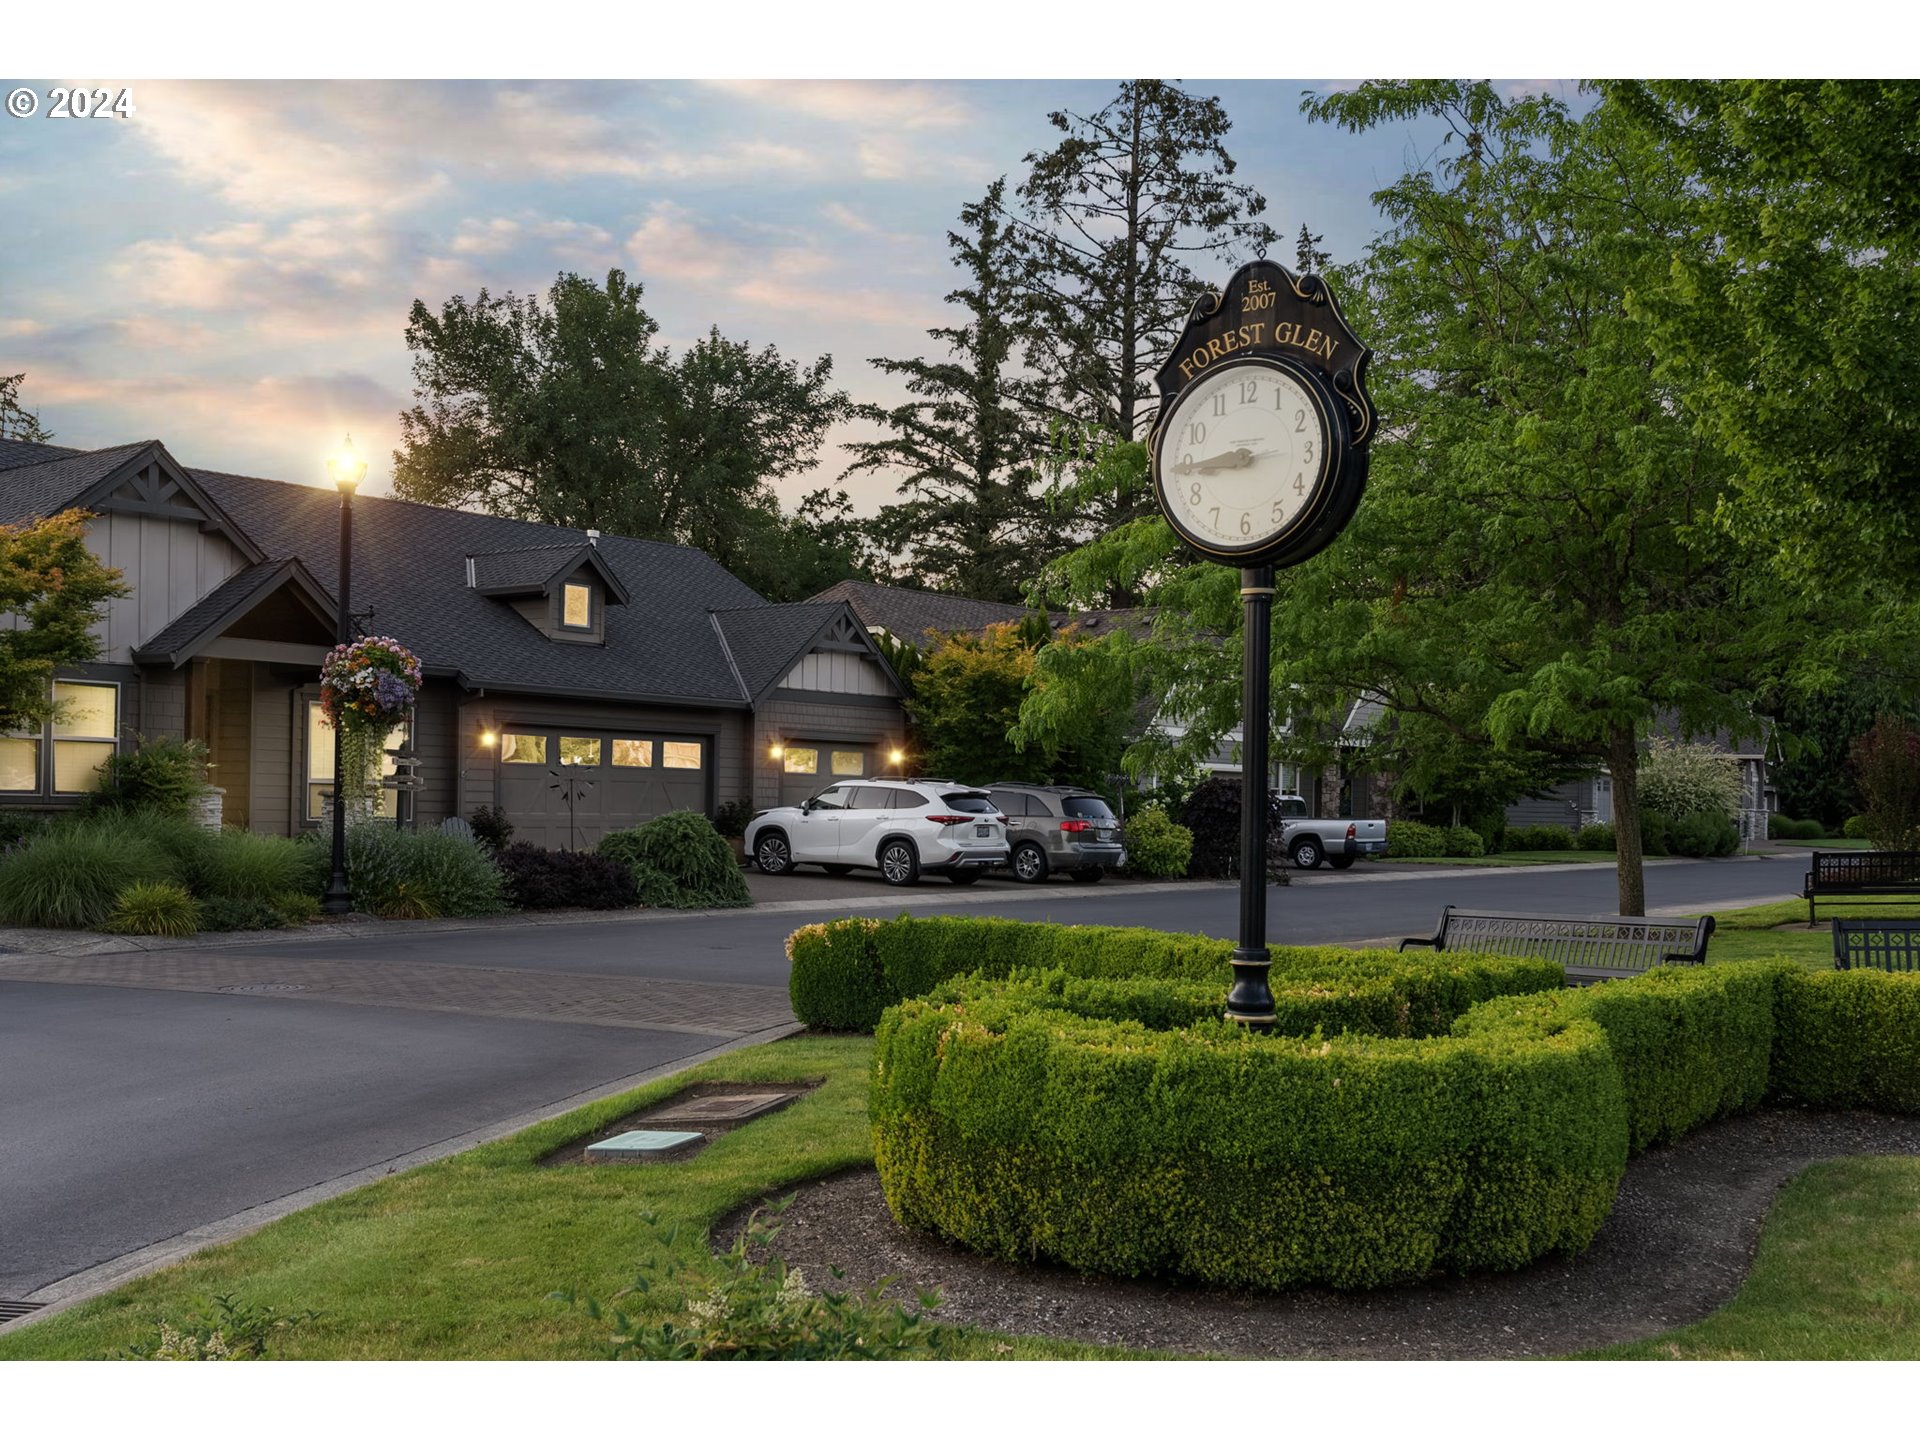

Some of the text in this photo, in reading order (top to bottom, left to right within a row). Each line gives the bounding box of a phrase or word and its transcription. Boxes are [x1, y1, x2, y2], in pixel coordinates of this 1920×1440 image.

[1248, 279, 1271, 294] Est.
[1241, 292, 1276, 312] 2007
[1178, 322, 1339, 380] FOREST GLEN
[1239, 381, 1258, 405] 12
[1274, 388, 1282, 411] 1
[1212, 394, 1226, 417] 11
[1295, 409, 1307, 433] 2
[1188, 422, 1206, 445] 10
[1303, 440, 1314, 464] 3
[1190, 482, 1202, 506] 8
[1293, 472, 1305, 497] 4
[1208, 507, 1221, 530] 7
[1271, 499, 1284, 524] 5
[1240, 512, 1251, 536] 6
